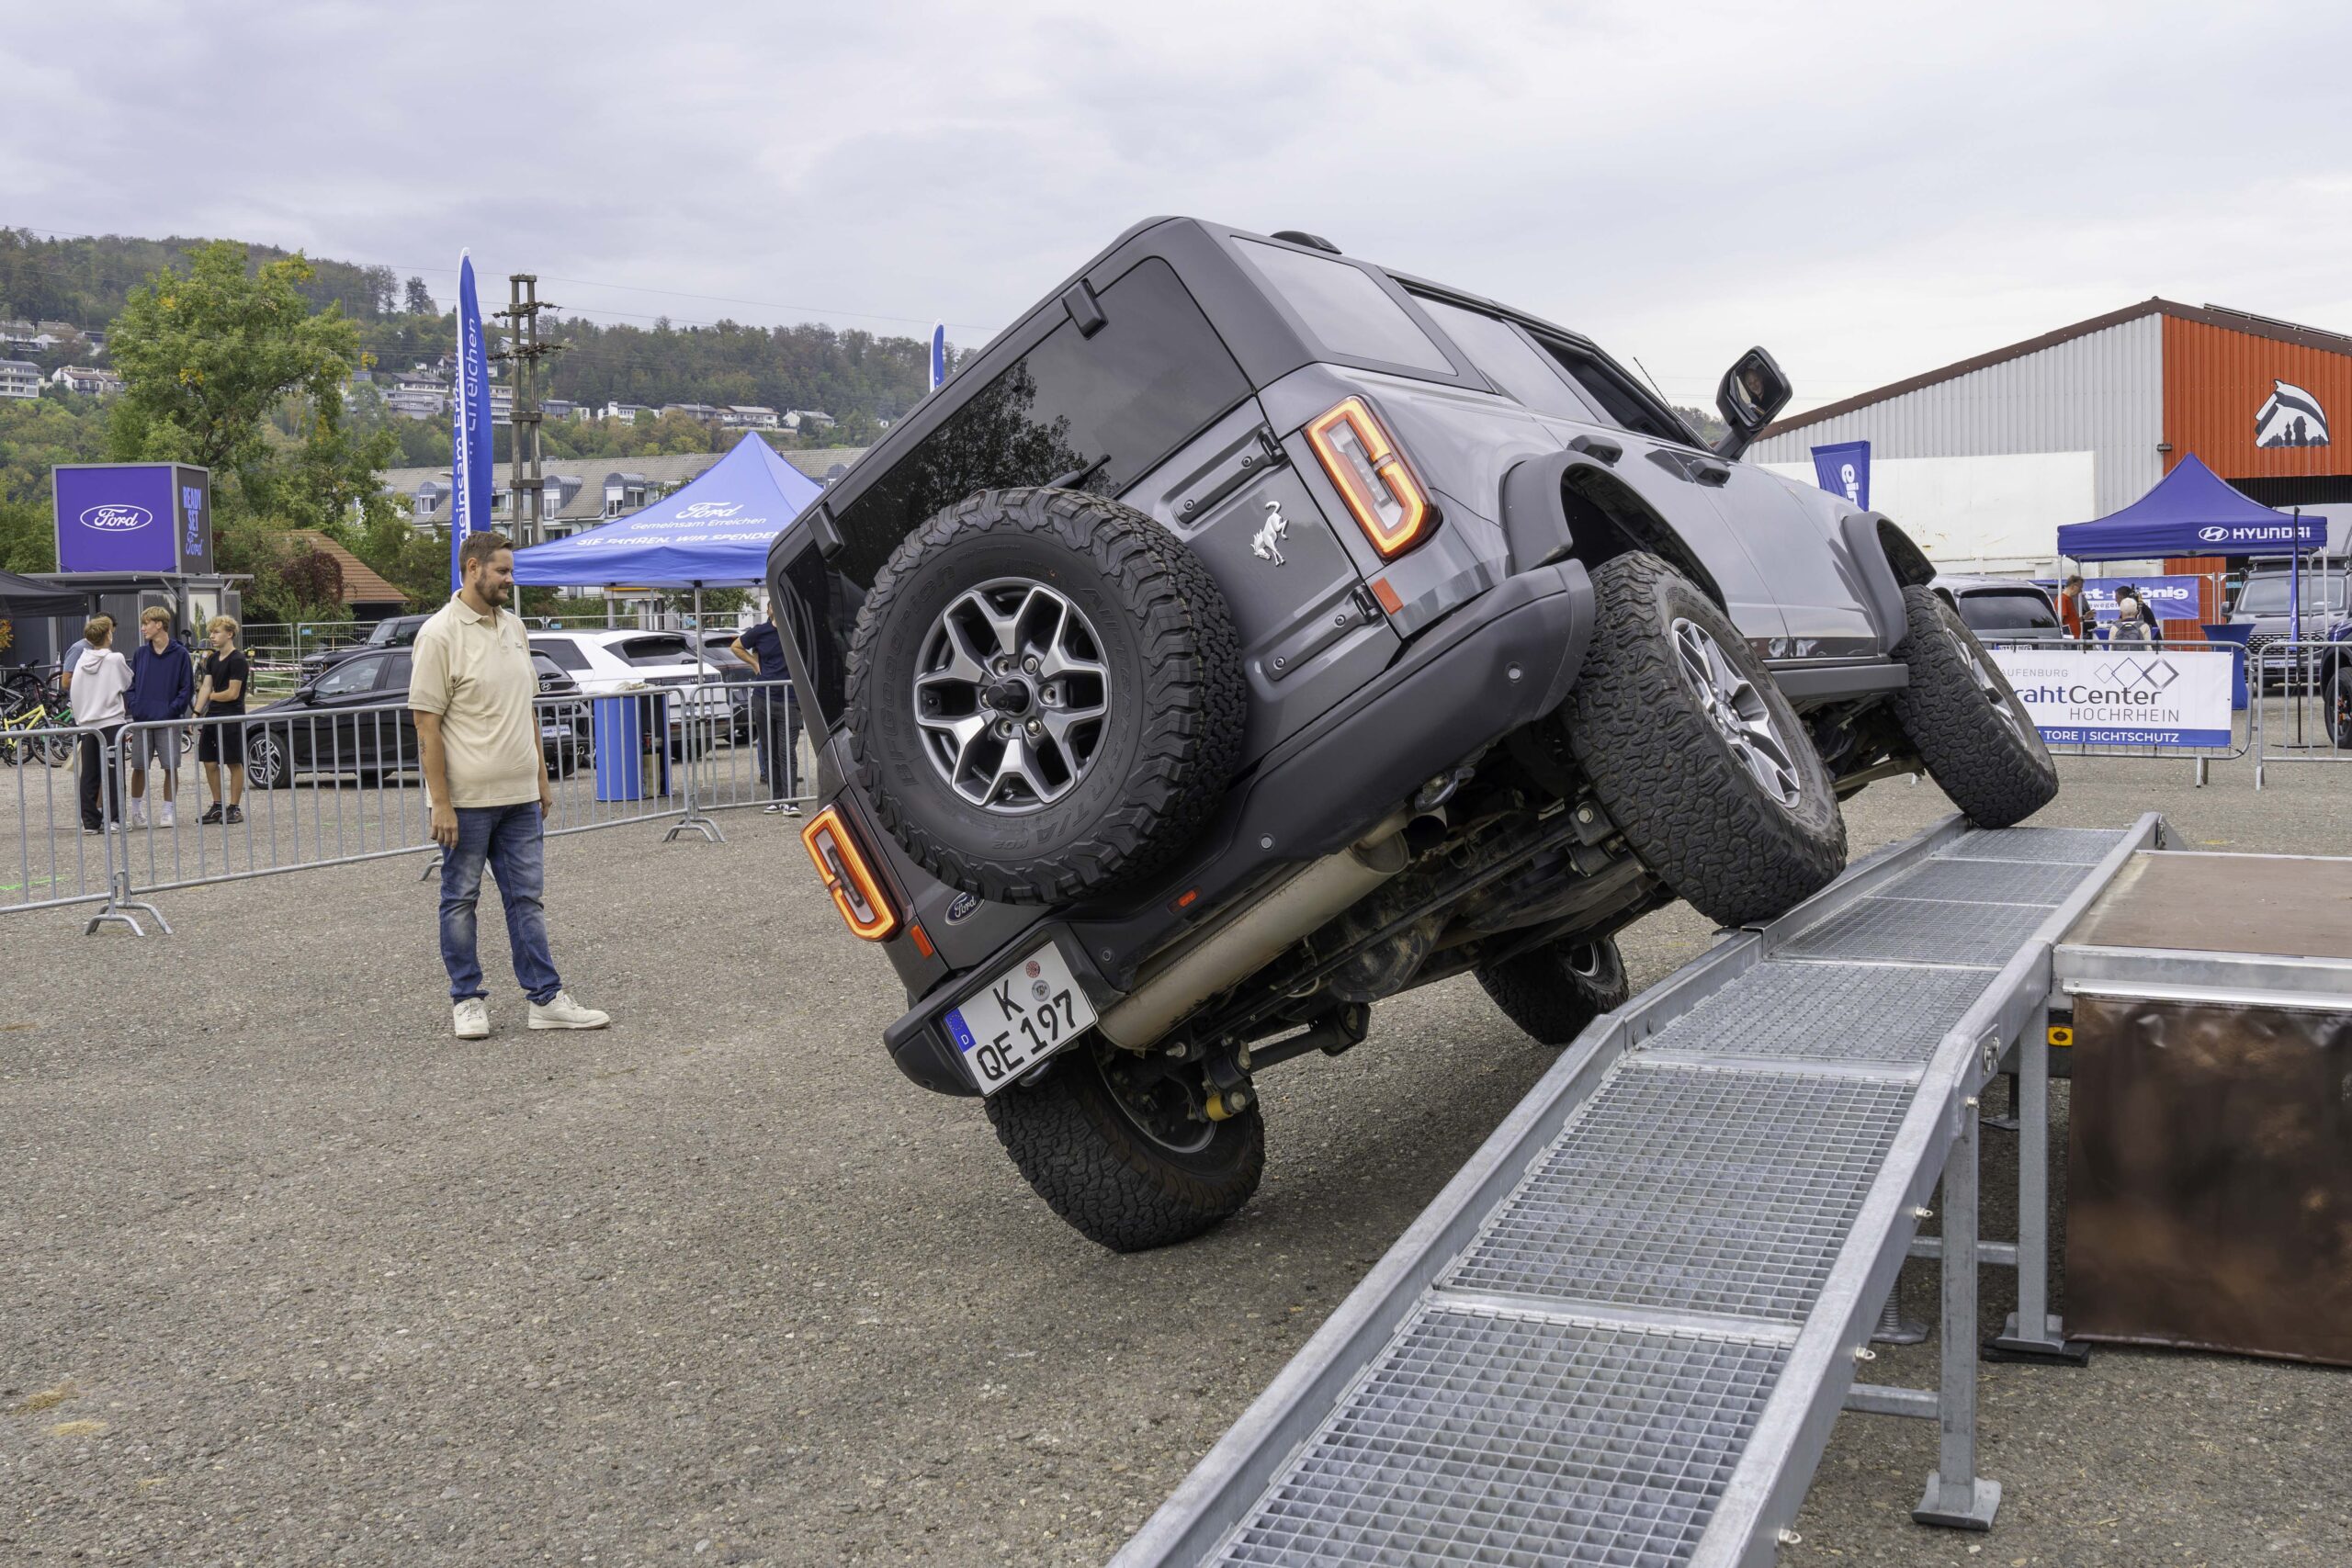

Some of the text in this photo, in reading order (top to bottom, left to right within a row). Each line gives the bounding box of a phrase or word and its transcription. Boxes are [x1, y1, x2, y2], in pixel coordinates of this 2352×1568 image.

[183, 486, 201, 510] READY
[94, 507, 139, 526] Ford
[676, 502, 744, 519] Ford
[187, 509, 198, 531] SET
[630, 517, 767, 530] Gemeinsam Erreichen
[2233, 527, 2311, 539] HYUNDAI
[186, 530, 203, 556] Ford
[2140, 587, 2189, 600] önig
[2001, 669, 2069, 677] AUFENBURG
[2014, 685, 2162, 705] rahtCenter
[2070, 707, 2180, 722] HOCHRHEIN
[2044, 730, 2180, 743] TORE SICHTSCHUTZ
[954, 896, 977, 919] Ford
[992, 979, 1025, 1021] K
[960, 1034, 970, 1045] D
[976, 988, 1077, 1081] QE 197
